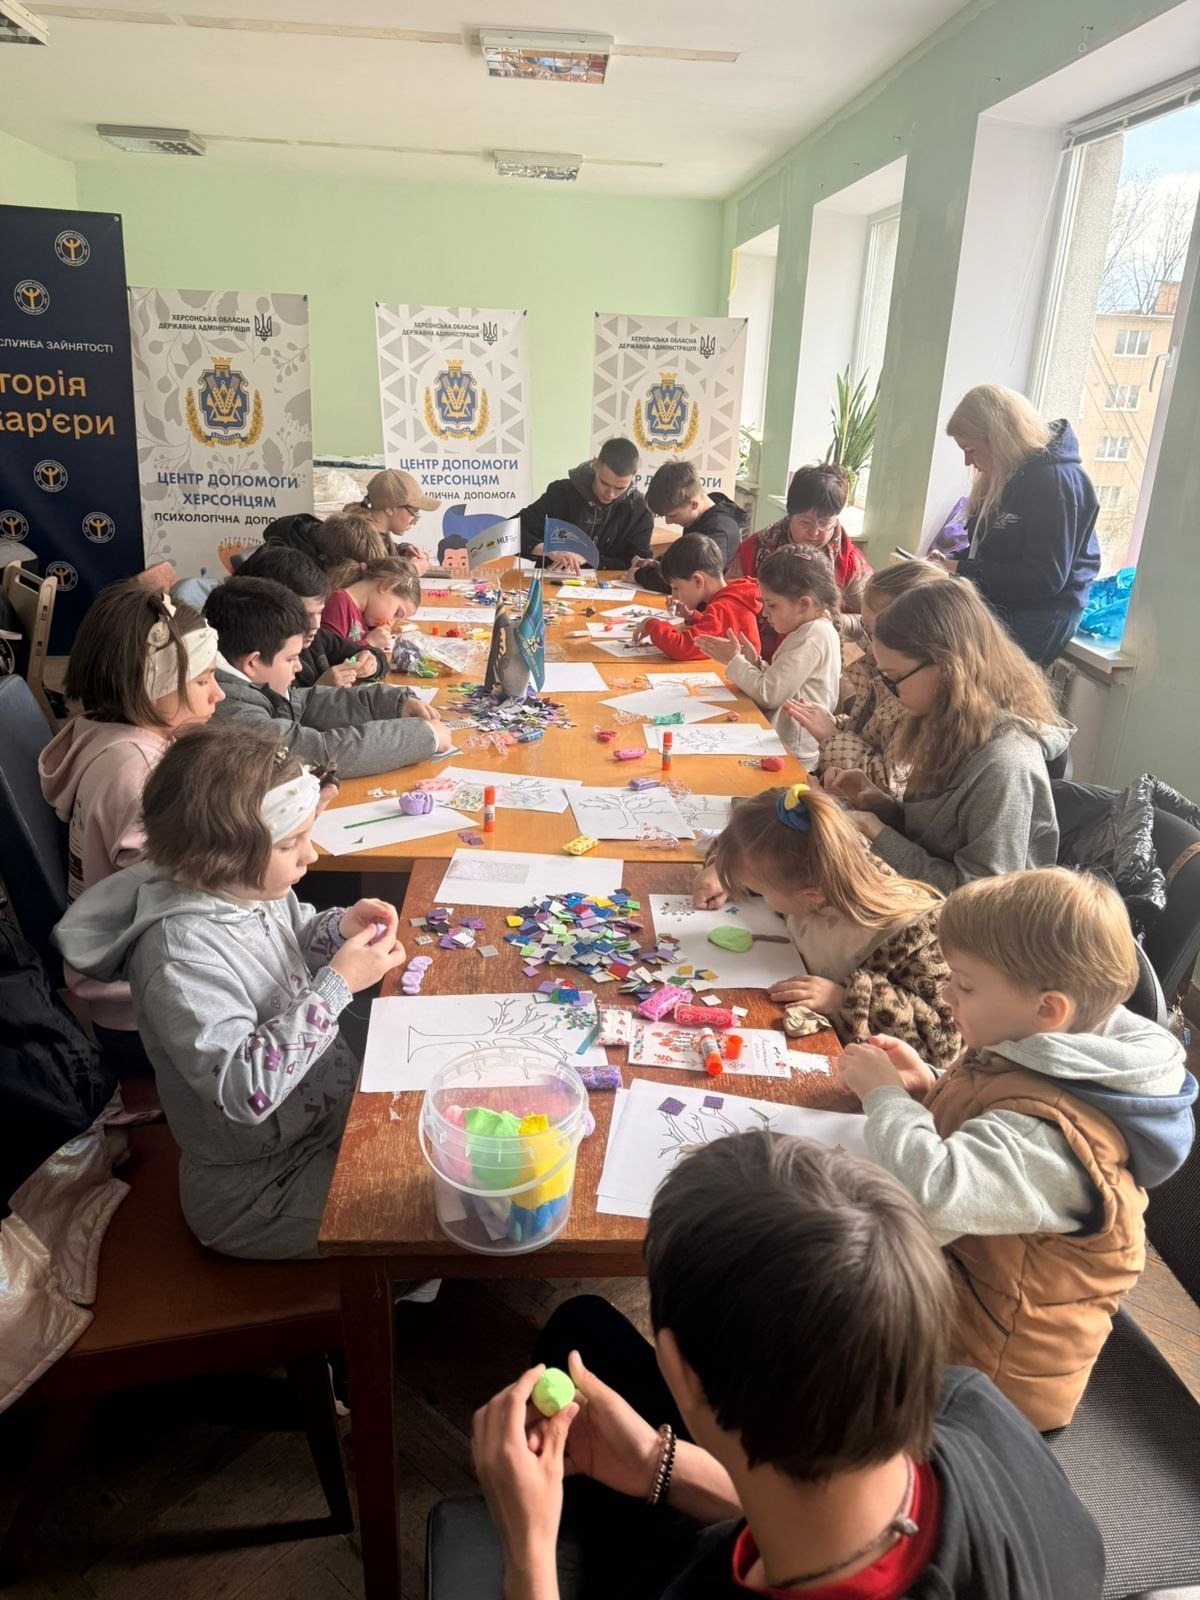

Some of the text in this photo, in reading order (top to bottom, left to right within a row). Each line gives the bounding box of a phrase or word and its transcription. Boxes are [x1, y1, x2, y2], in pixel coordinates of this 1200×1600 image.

[172, 314, 250, 324] ХЕРСОНСЬКА ОБЛАСНА
[158, 322, 196, 331] ДЕРЖАВНА
[46, 340, 114, 353] ЗАЙНЯТОСТІ
[0, 408, 115, 440] ар'єри
[400, 459, 518, 471] ЦЕНТР ДОПОМОГИ
[157, 472, 298, 489] ЦЕНТР ДОПОМОГИ
[421, 474, 500, 487] ХЕРСОНЦЯМ
[182, 493, 276, 509] ХЕРСОНЦЯМ
[464, 491, 516, 500] ДОПОМОГА
[154, 512, 280, 525] ПСИХОЛОГІЧНА ДОПО
